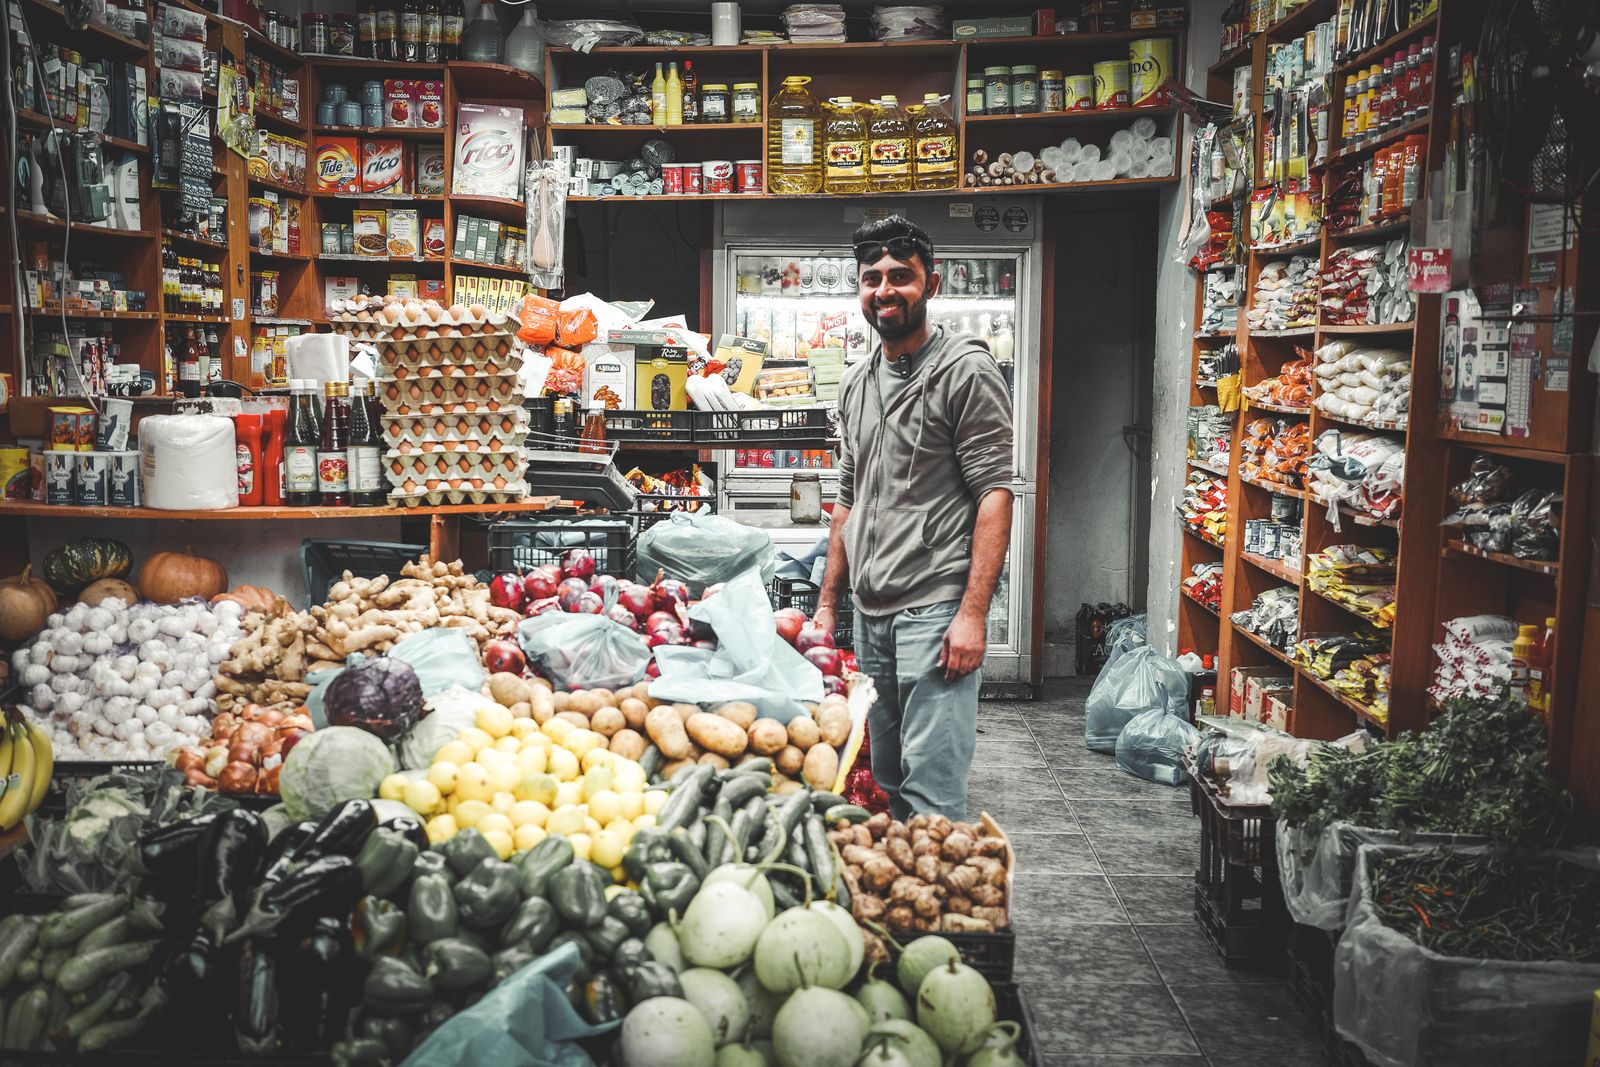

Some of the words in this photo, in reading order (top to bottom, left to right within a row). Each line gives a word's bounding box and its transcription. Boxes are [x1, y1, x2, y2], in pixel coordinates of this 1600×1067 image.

[463, 141, 514, 166] rico
[319, 160, 343, 177] Tide
[365, 156, 399, 176] rico
[823, 314, 846, 331] TWIST
